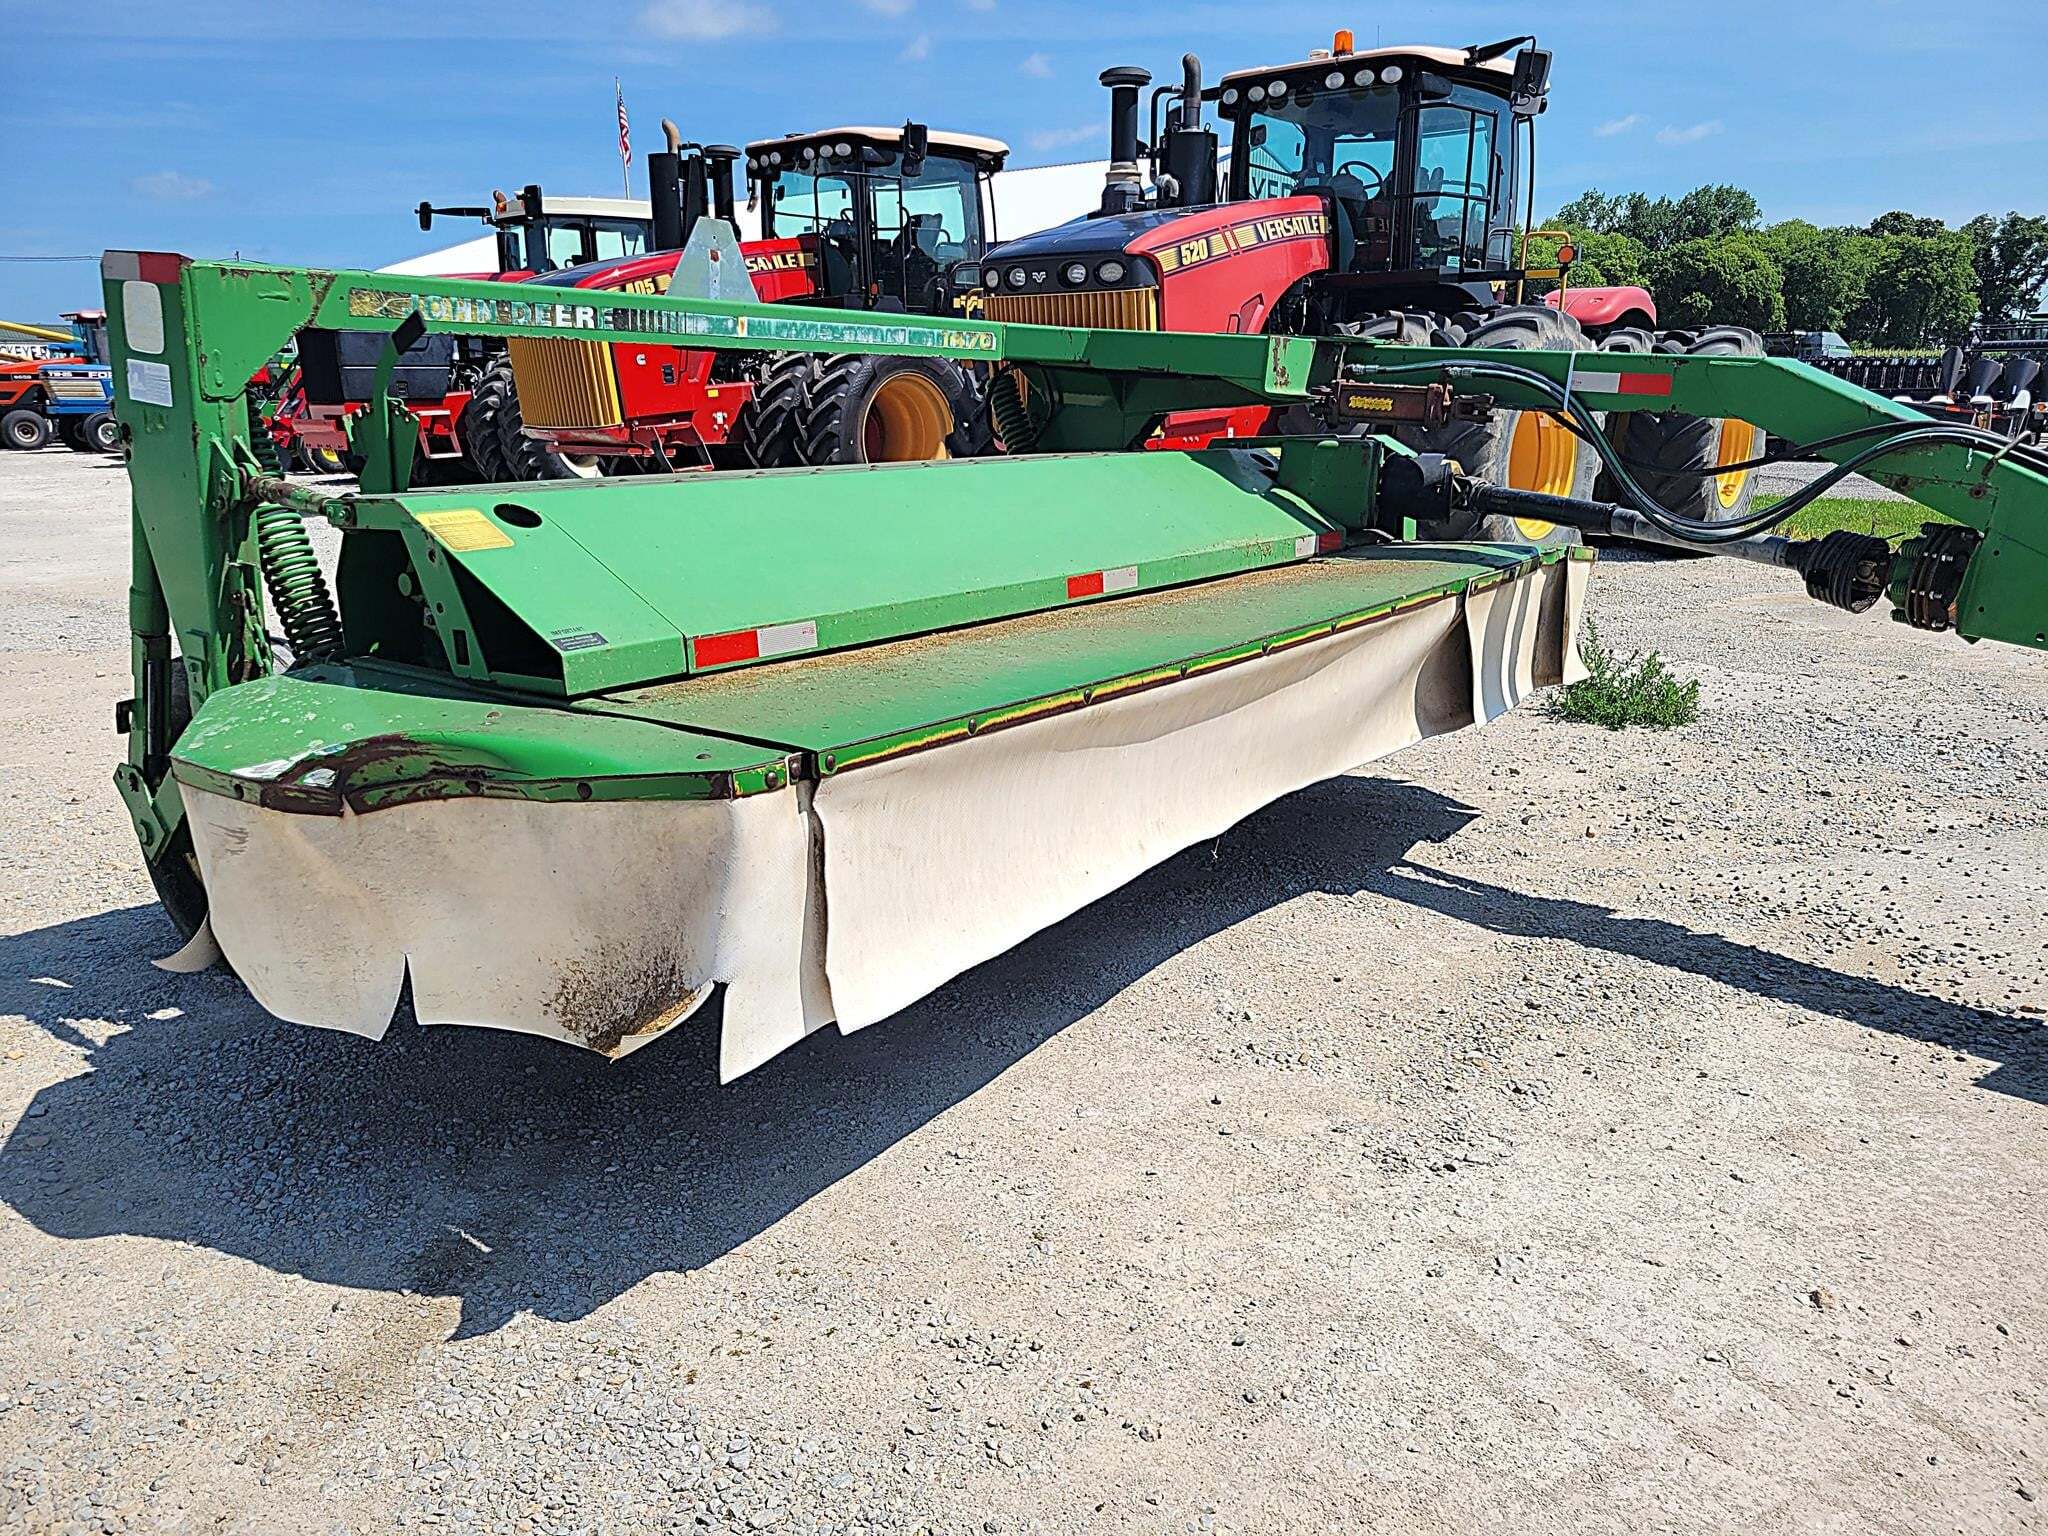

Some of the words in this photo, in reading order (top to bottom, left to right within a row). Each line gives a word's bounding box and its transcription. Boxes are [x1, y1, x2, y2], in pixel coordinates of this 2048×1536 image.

[1180, 238, 1208, 265] 520
[1256, 215, 1320, 242] VERSATILE
[625, 277, 656, 295] 405
[745, 253, 798, 273] SATILE
[405, 293, 497, 323] JOHN
[511, 301, 613, 330] DEERE
